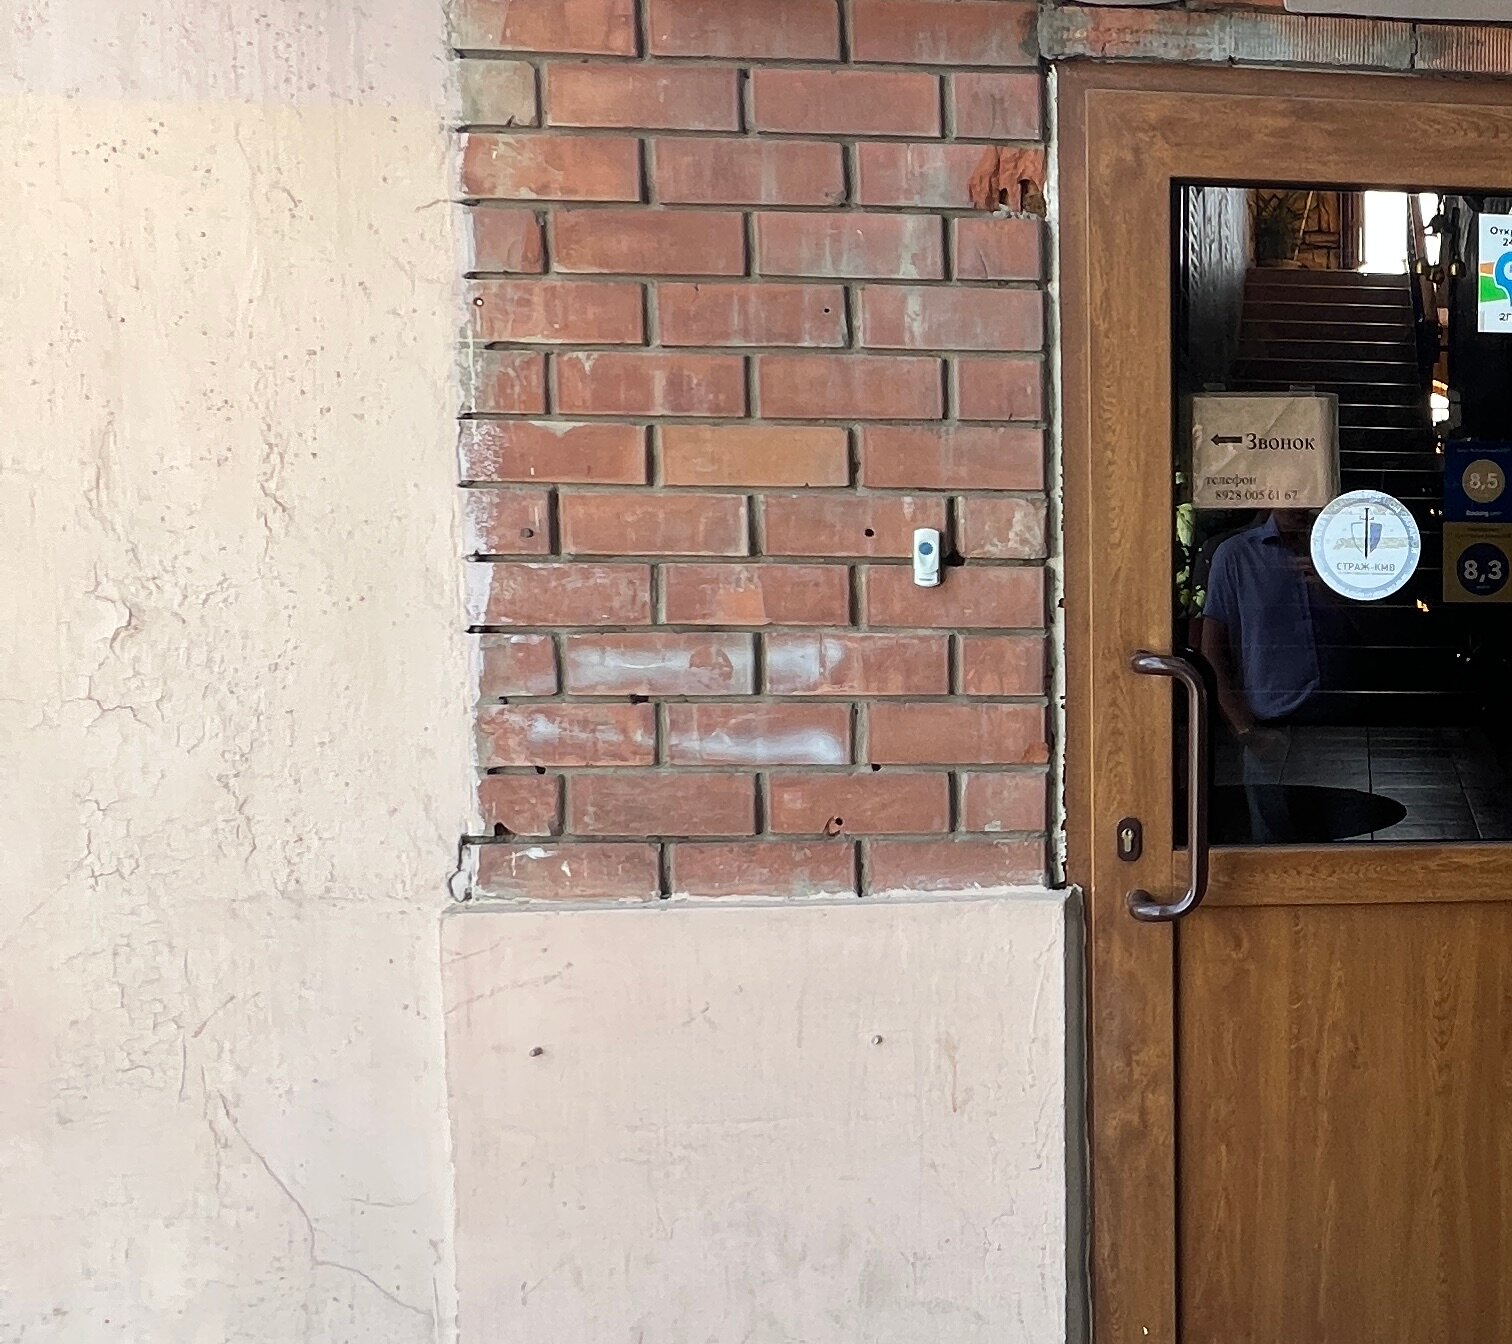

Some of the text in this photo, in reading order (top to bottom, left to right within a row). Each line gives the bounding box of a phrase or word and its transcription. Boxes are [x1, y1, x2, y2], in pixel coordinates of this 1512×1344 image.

[1246, 433, 1316, 451] Звонок
[1205, 474, 1257, 487] телефон
[1469, 472, 1498, 490] 8,5
[1215, 489, 1242, 500] 8928
[1244, 489, 1265, 500] 005
[1284, 489, 1298, 500] 67
[1464, 559, 1502, 583] 8,3
